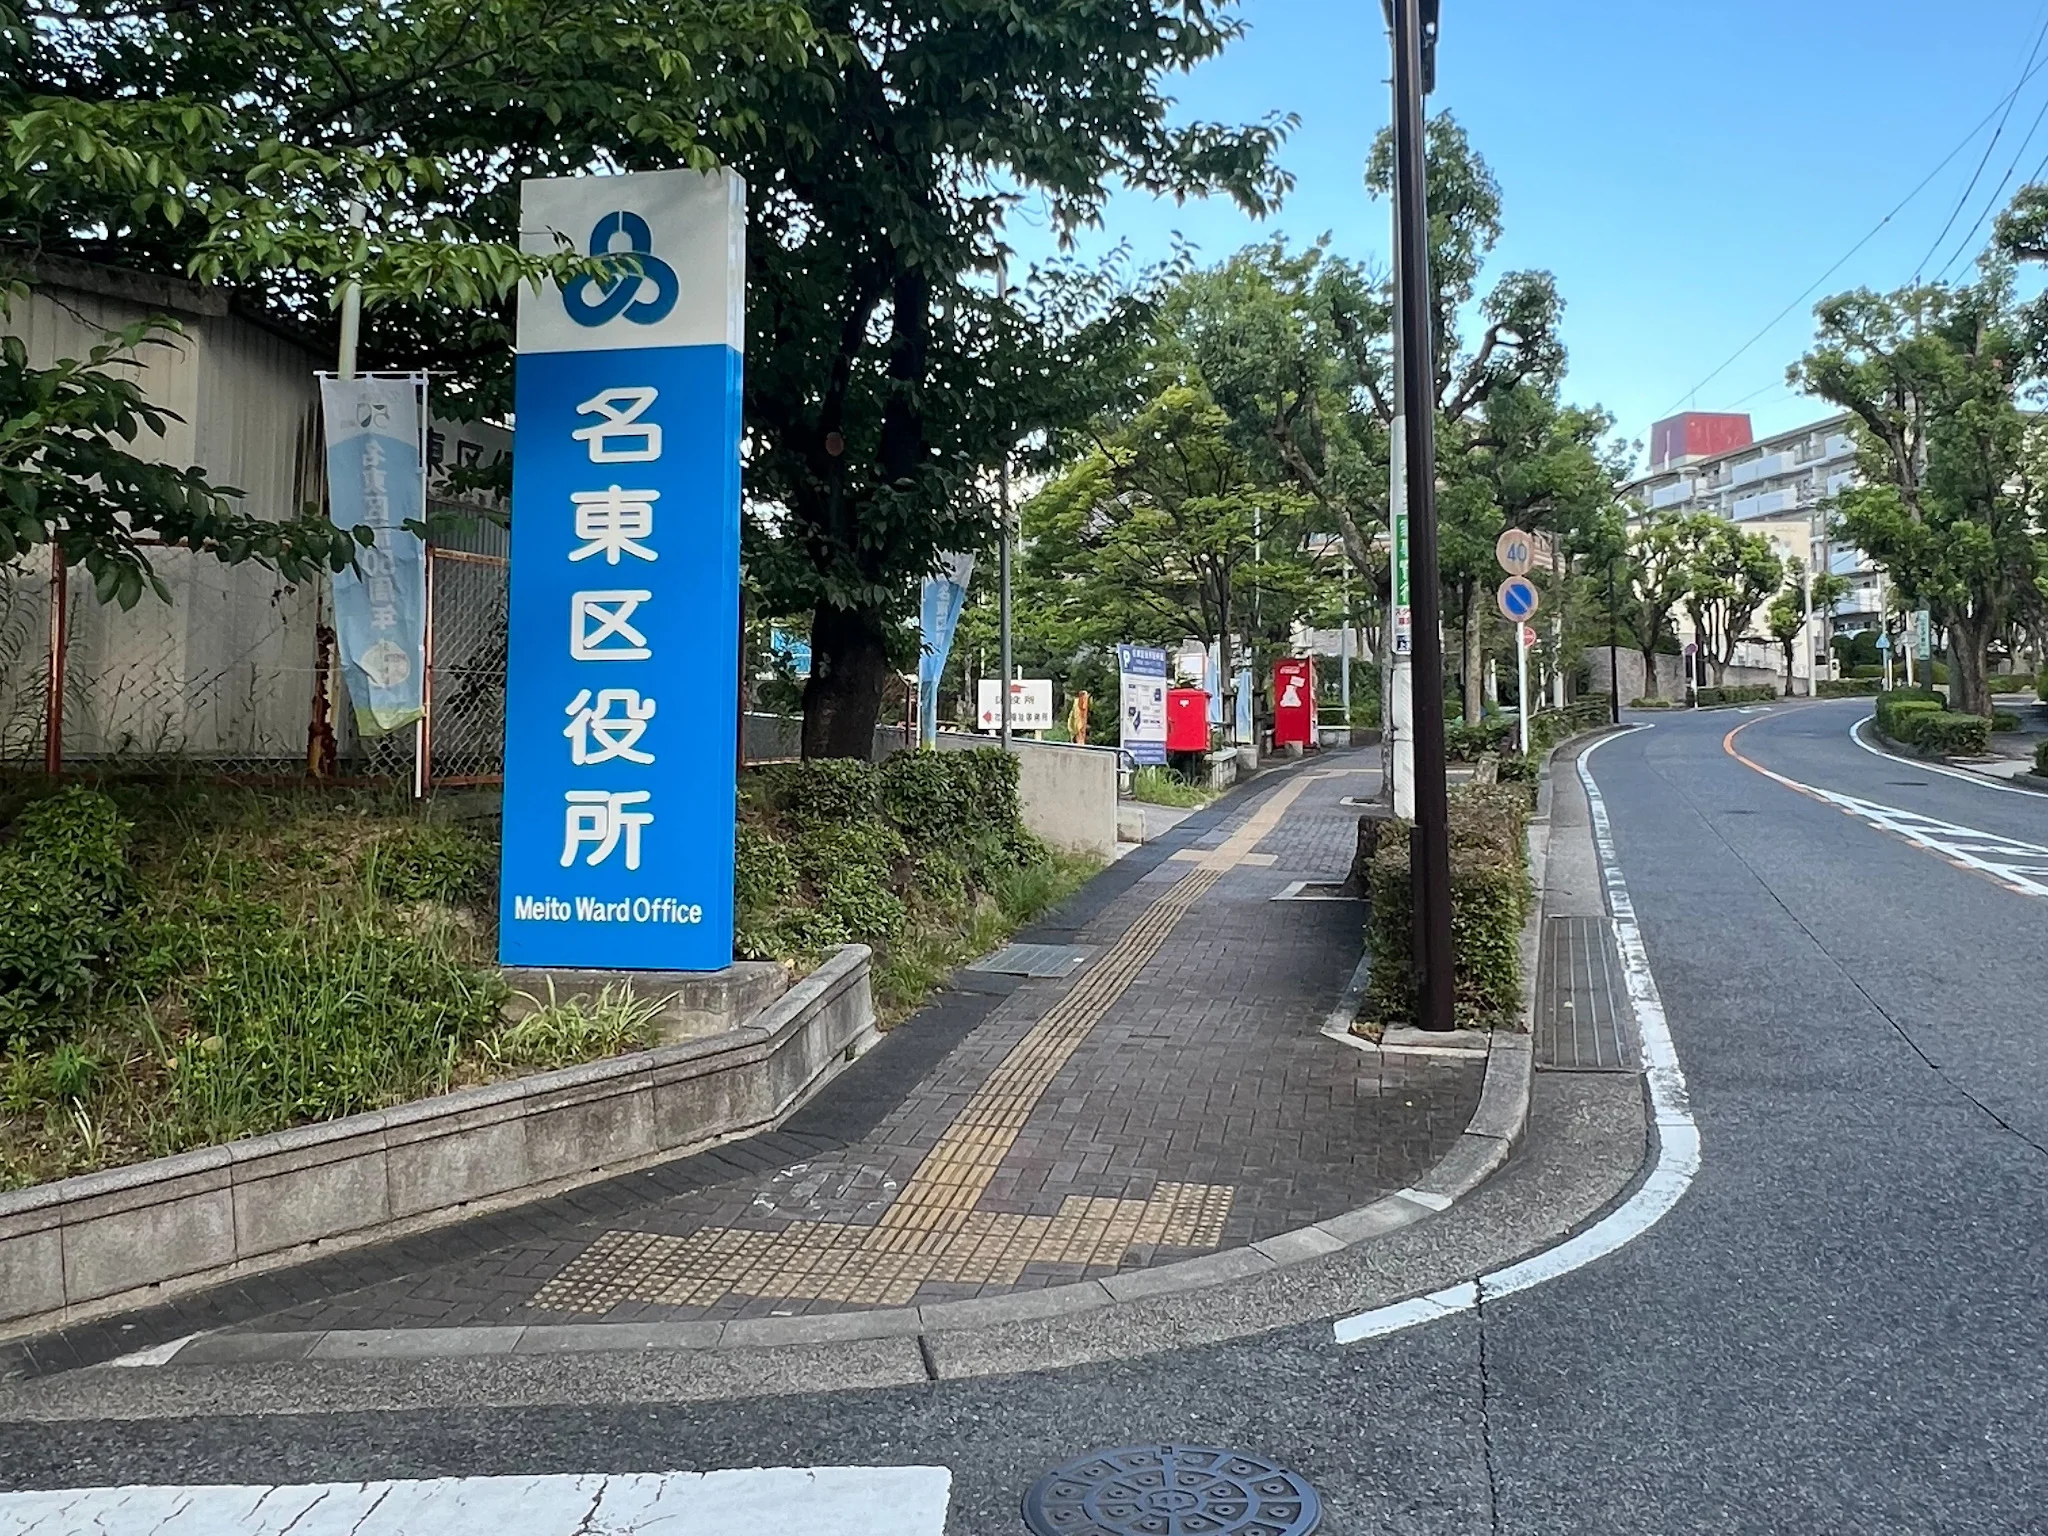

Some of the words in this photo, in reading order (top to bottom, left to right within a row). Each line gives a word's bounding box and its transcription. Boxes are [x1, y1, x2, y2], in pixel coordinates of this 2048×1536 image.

[1507, 543, 1527, 562] 40
[560, 386, 663, 872] 名東区役所
[514, 895, 572, 921] Meito
[575, 896, 630, 922] Ward
[633, 896, 702, 924] Office
